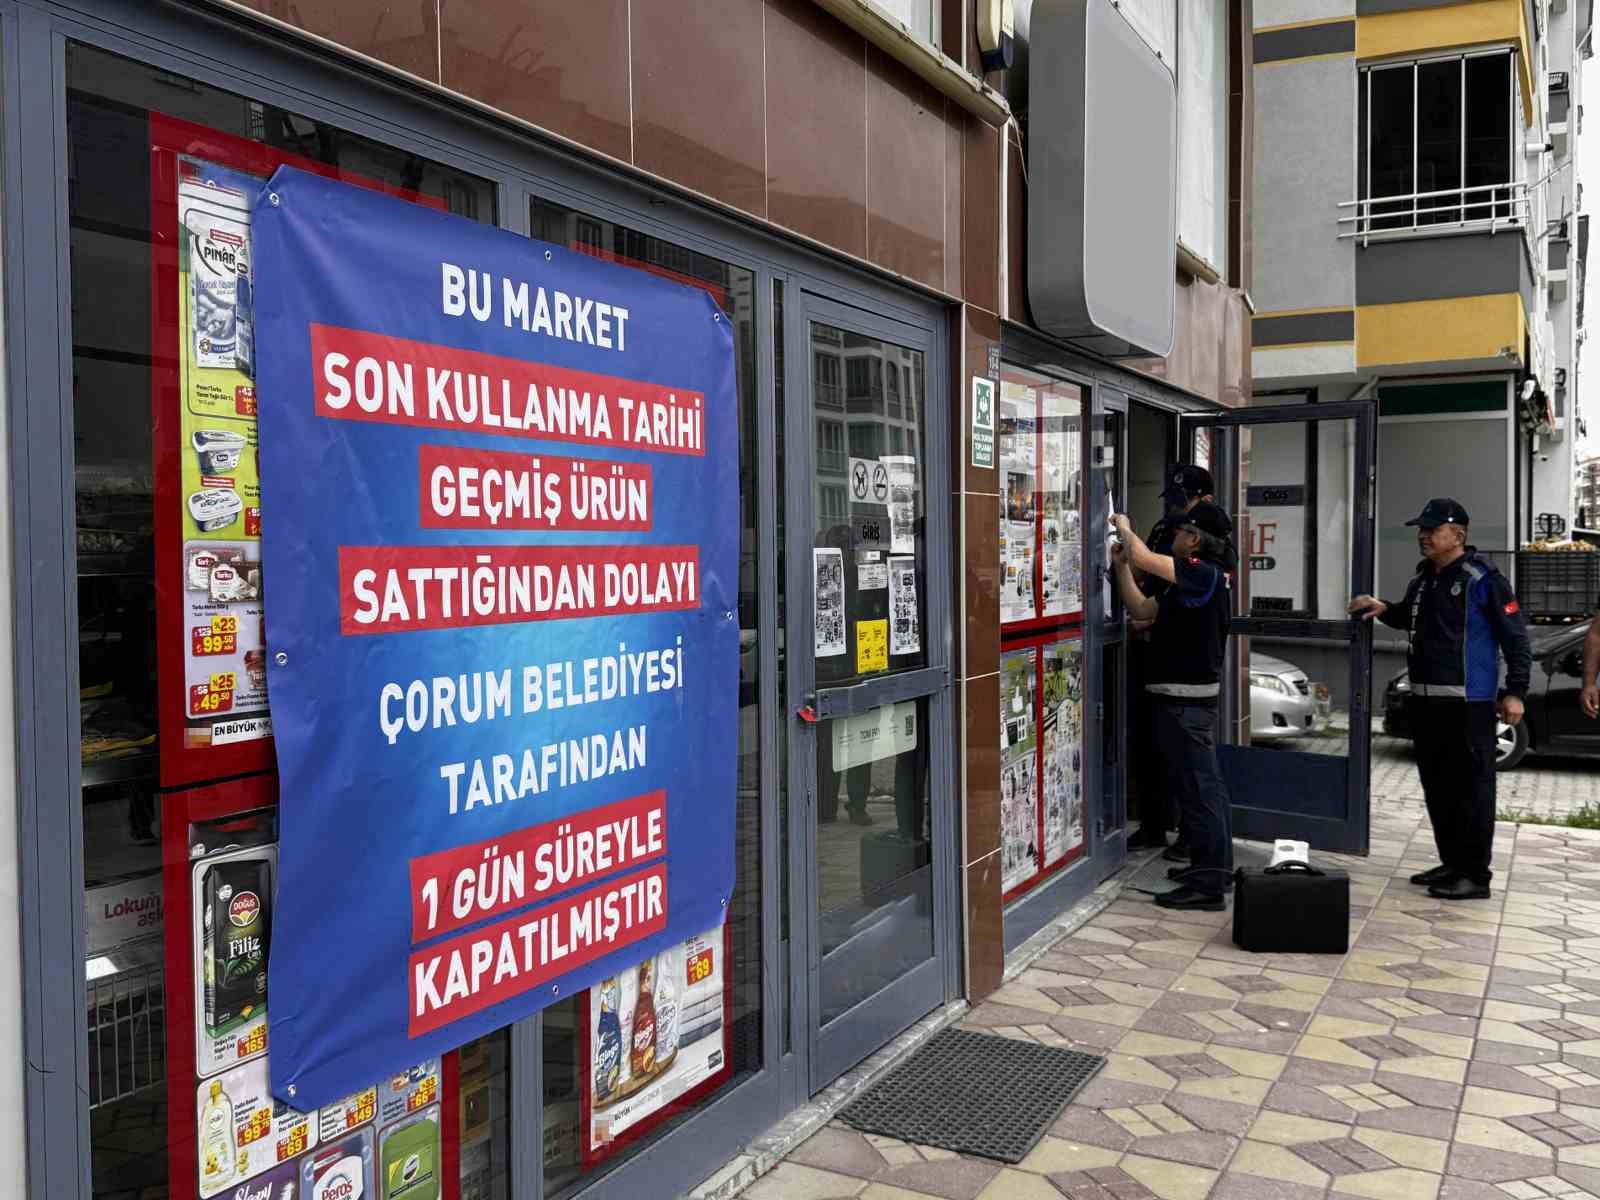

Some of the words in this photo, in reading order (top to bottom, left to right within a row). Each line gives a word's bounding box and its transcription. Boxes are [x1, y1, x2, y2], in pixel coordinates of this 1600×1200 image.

[442, 262, 491, 321] BU
[503, 277, 629, 352] MARKET
[323, 352, 415, 418] SON
[426, 367, 613, 440] KULLANMA
[618, 393, 701, 450] TARİHİ
[431, 458, 562, 526] GEÇMİŞ
[570, 462, 648, 521] ÜRÜN
[353, 555, 596, 624] SATTIĞINDAN
[603, 561, 696, 607] DOLAYI
[214, 725, 226, 737] EN
[226, 720, 257, 735] BÜYÜK
[379, 669, 512, 745] ÇORUM
[522, 636, 684, 714] BELEDİYESİ
[440, 725, 647, 815] TARAFINDAN
[421, 878, 439, 930] 1
[453, 846, 525, 919] GÜN
[534, 808, 662, 892] SÜREYLE
[229, 935, 261, 959] Filiz
[415, 875, 664, 1017] KAPATILMIŞTIR
